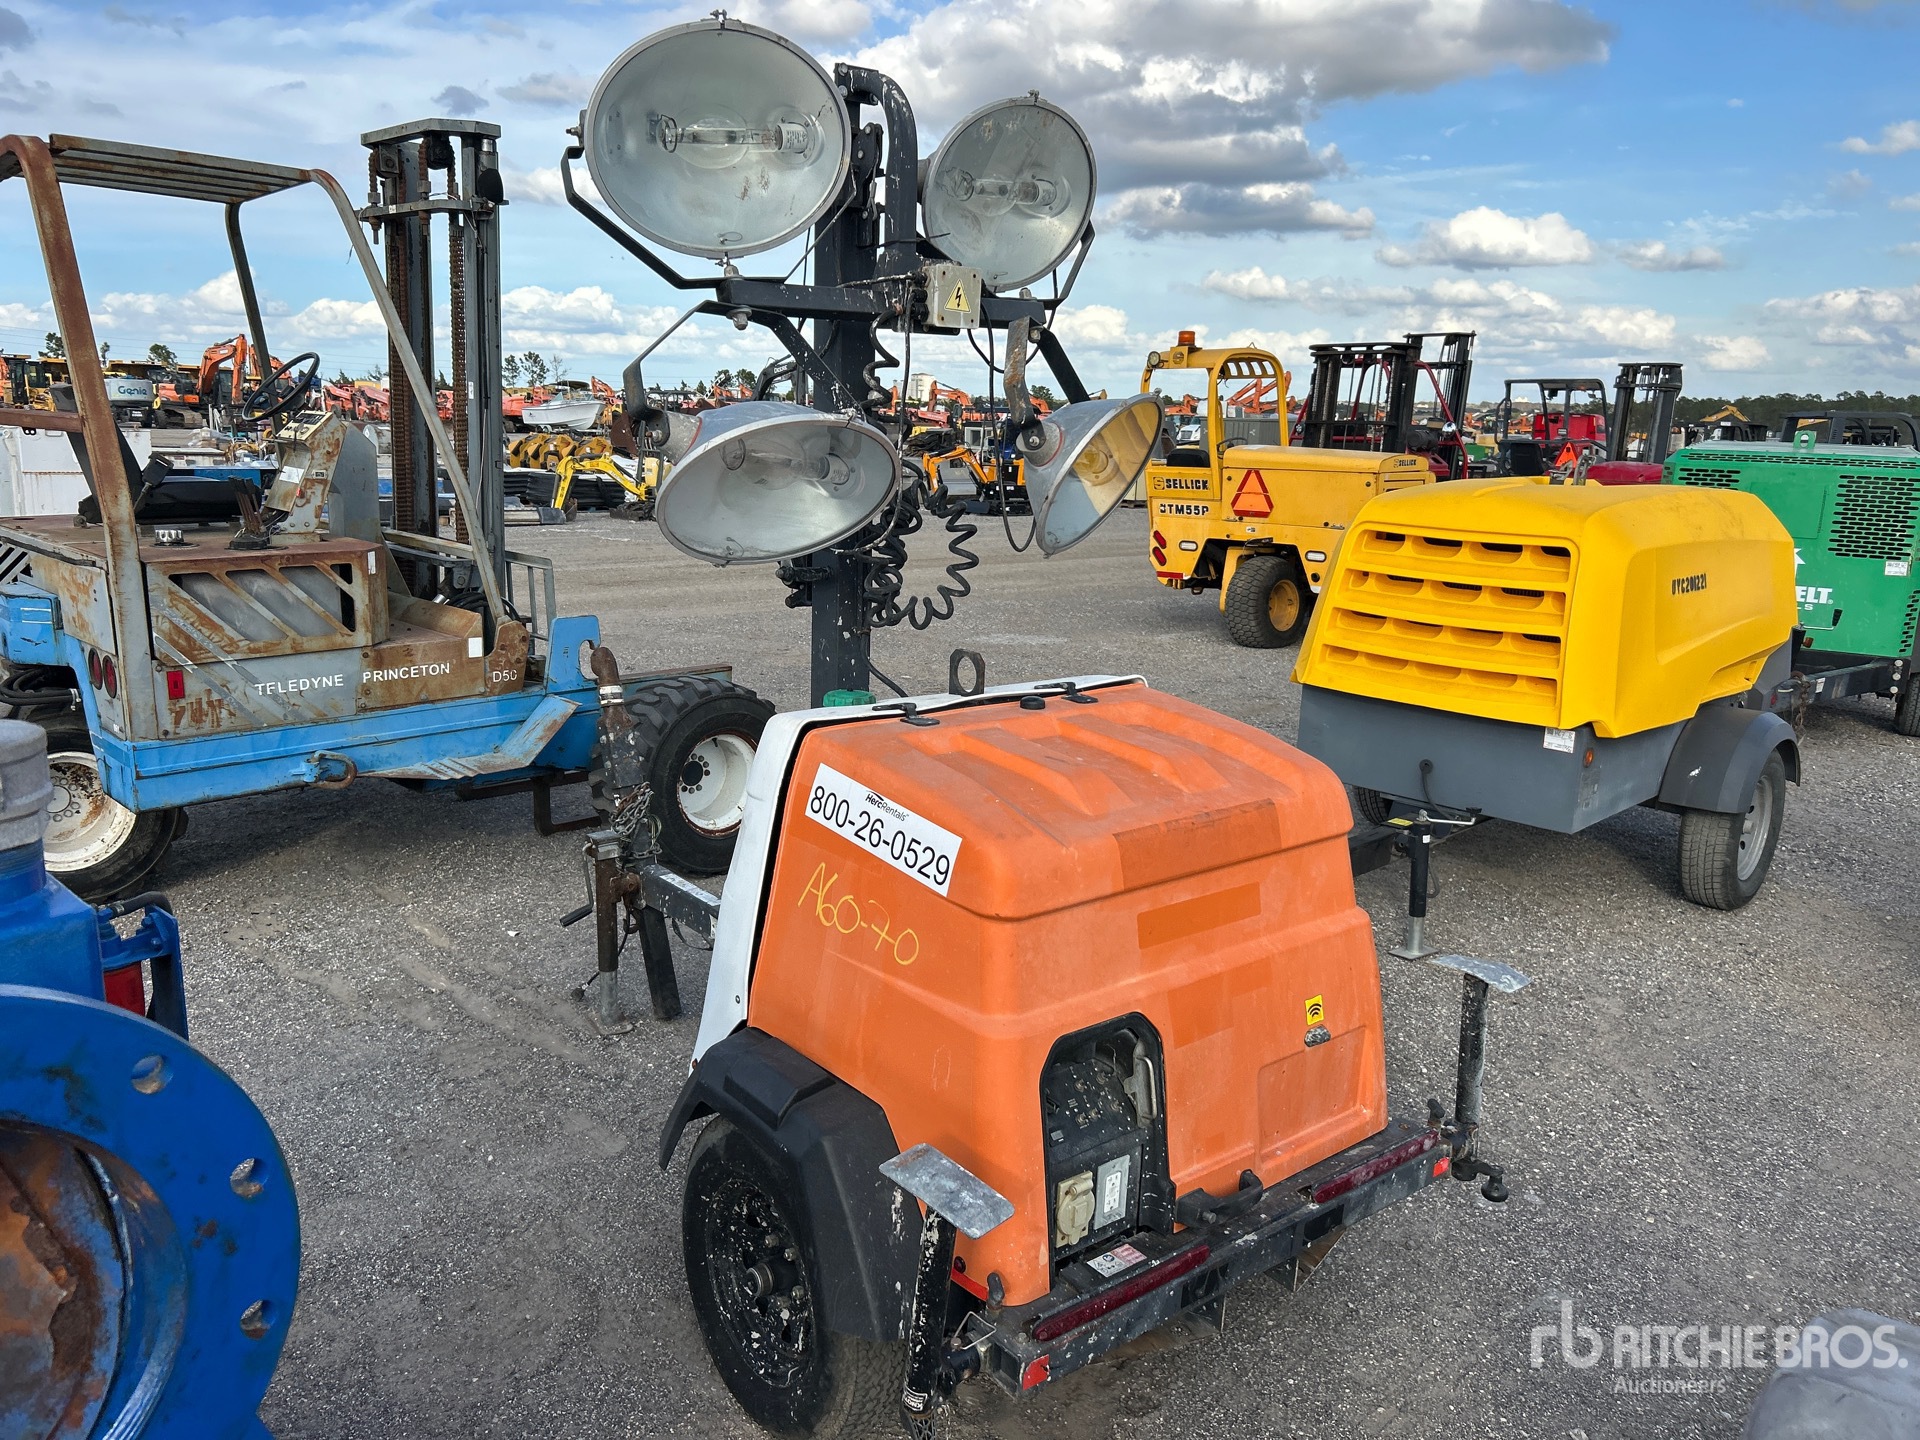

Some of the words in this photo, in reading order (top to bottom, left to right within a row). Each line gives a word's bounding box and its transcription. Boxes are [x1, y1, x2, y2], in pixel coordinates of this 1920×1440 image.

[117, 385, 148, 396] Genie
[1398, 459, 1417, 467] SELLICK
[1165, 478, 1209, 491] SELLICK
[255, 673, 345, 696] TELEDYNE
[362, 662, 451, 684] PRINCETON
[810, 785, 950, 886] 800-26-0529
